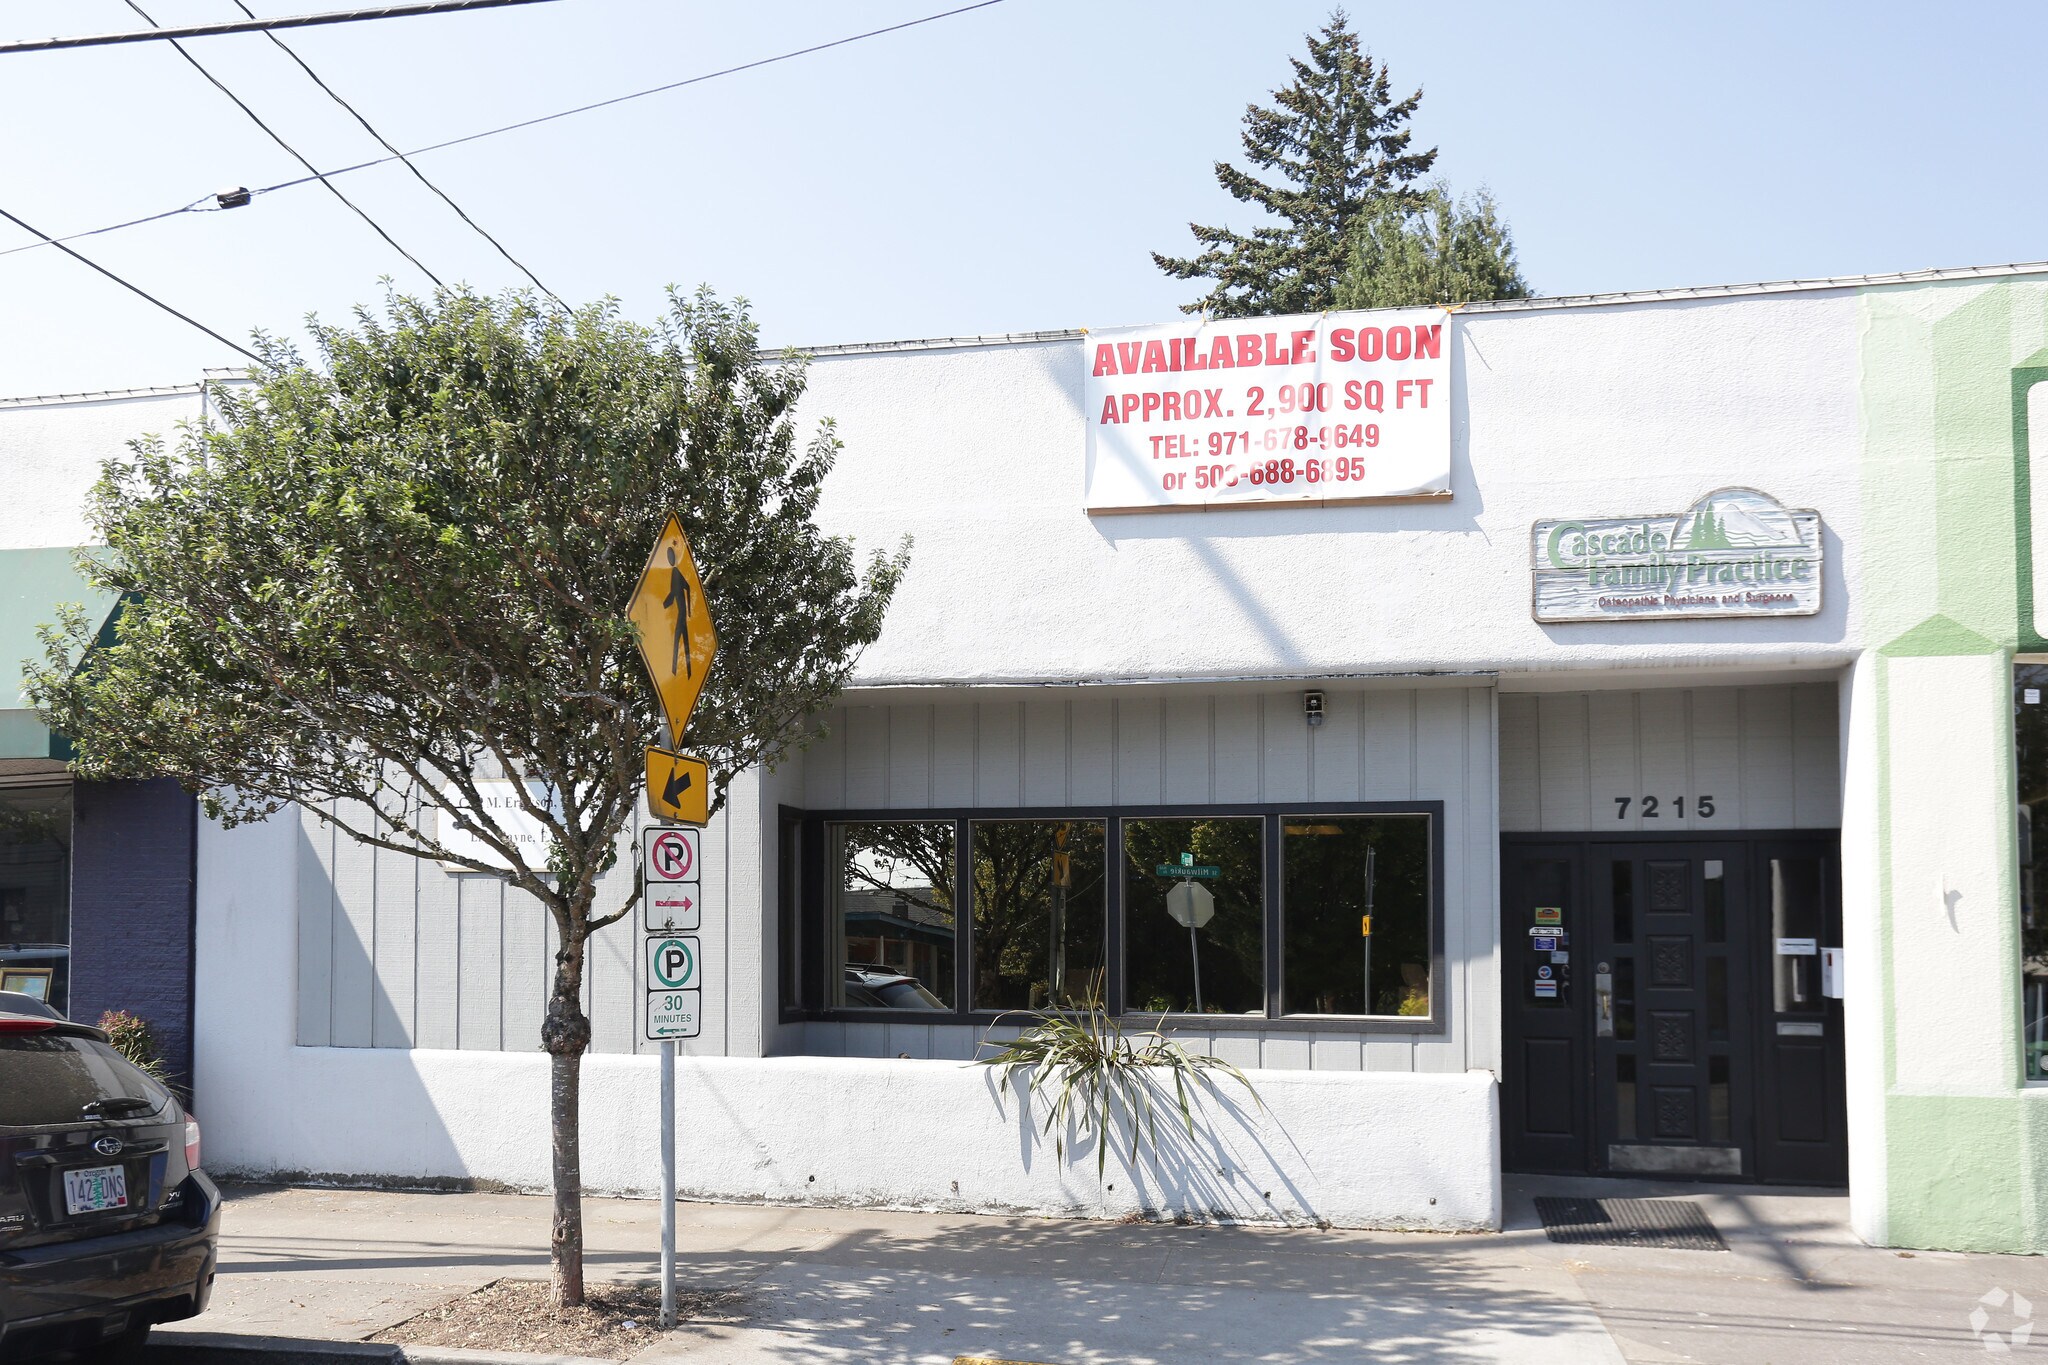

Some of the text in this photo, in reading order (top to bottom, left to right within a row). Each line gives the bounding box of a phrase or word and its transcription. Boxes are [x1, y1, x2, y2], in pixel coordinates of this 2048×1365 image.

[1092, 324, 1442, 377] AVAILABLE SOON
[1100, 379, 1433, 424] APPROX. 2,900 SQ FT
[1149, 423, 1380, 459] TEL: 971-678-9649
[1163, 471, 1186, 490] or
[1547, 522, 1667, 572] Cascade
[1588, 551, 1810, 592] Family Practice
[1599, 591, 1794, 608] Osteopathic Physicians and Surgeons
[1615, 796, 1715, 819] 7215
[665, 950, 685, 978] P
[664, 995, 682, 1011] 30
[654, 1014, 692, 1023] MINUTES
[83, 1169, 107, 1178] Oregon
